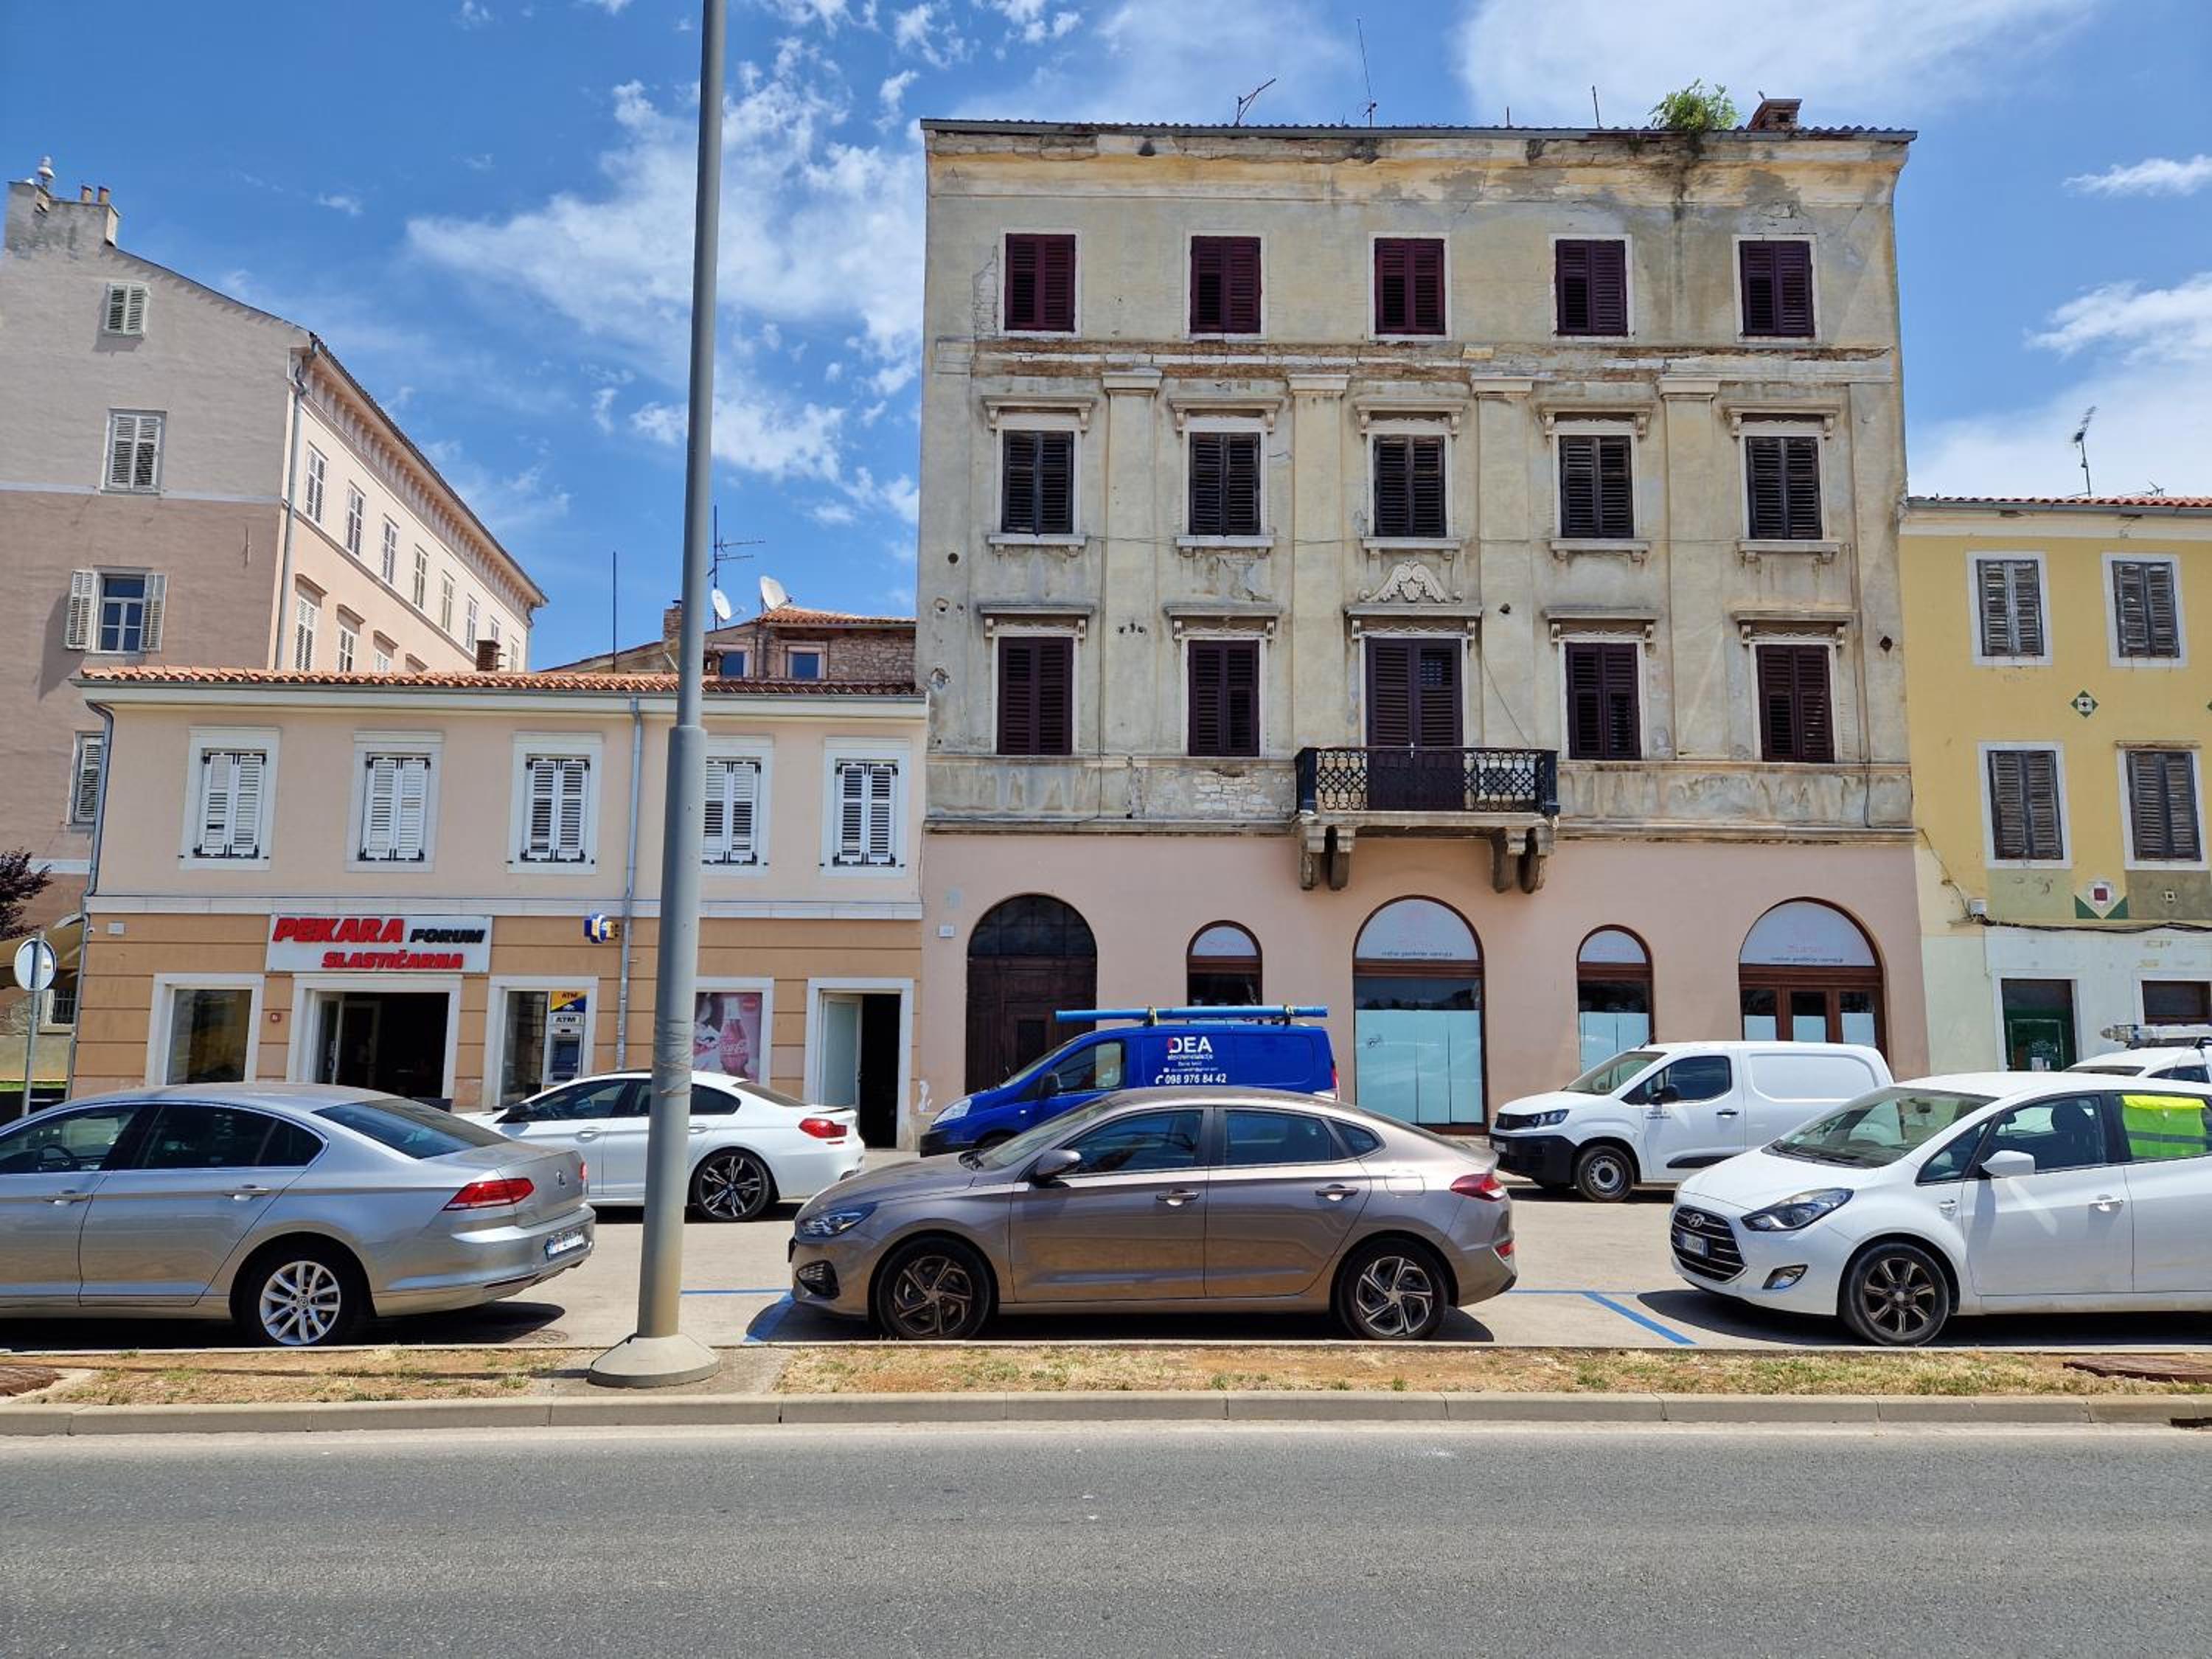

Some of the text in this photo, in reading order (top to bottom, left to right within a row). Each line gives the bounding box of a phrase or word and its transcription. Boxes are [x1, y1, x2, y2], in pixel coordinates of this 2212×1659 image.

[272, 917, 486, 943] PEKARA FORUM
[321, 949, 464, 969] SLASTIČARNA
[1167, 1037, 1213, 1054] DEA
[1165, 1073, 1227, 1085] 098 976 84 42
